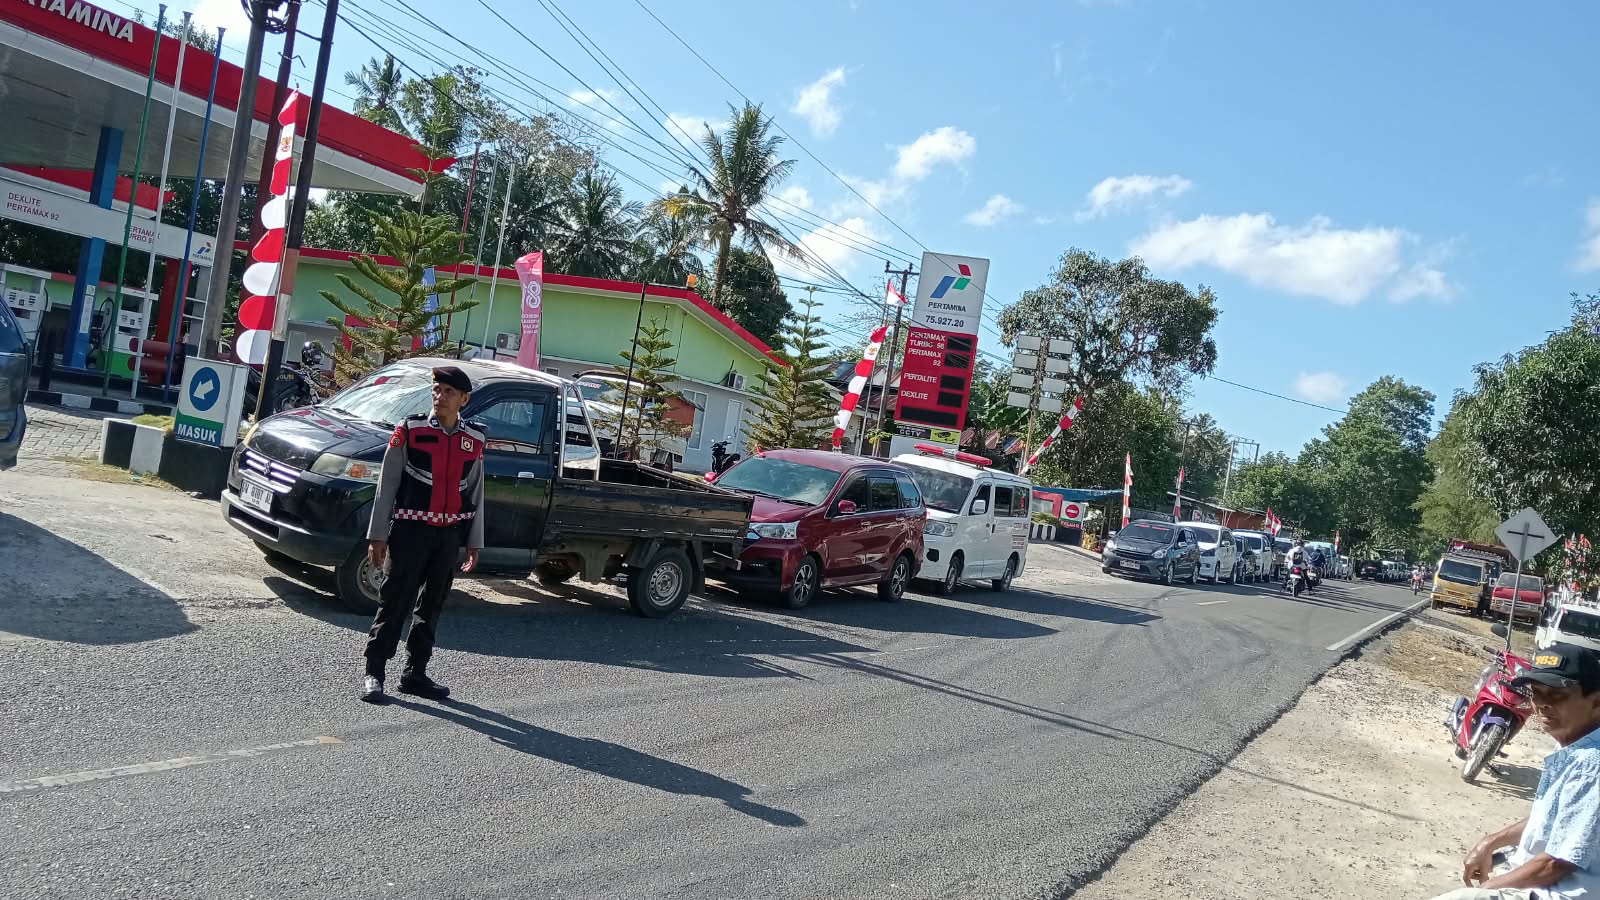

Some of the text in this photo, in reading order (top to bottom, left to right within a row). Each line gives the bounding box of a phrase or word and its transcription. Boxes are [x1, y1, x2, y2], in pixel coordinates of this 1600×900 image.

[8, 192, 42, 207] DEXLITE
[6, 202, 60, 221] PERTAMAX 92
[928, 301, 966, 312] PERTAMINA
[925, 315, 964, 327] 75.927.20
[910, 331, 945, 342] PERTAMAX
[909, 339, 934, 348] TURBO
[908, 348, 941, 358] PERTAMAX
[904, 372, 937, 383] PERTALITE
[901, 390, 928, 400] DEXLITE
[177, 423, 216, 442] MASUK
[899, 429, 921, 437] CCTV
